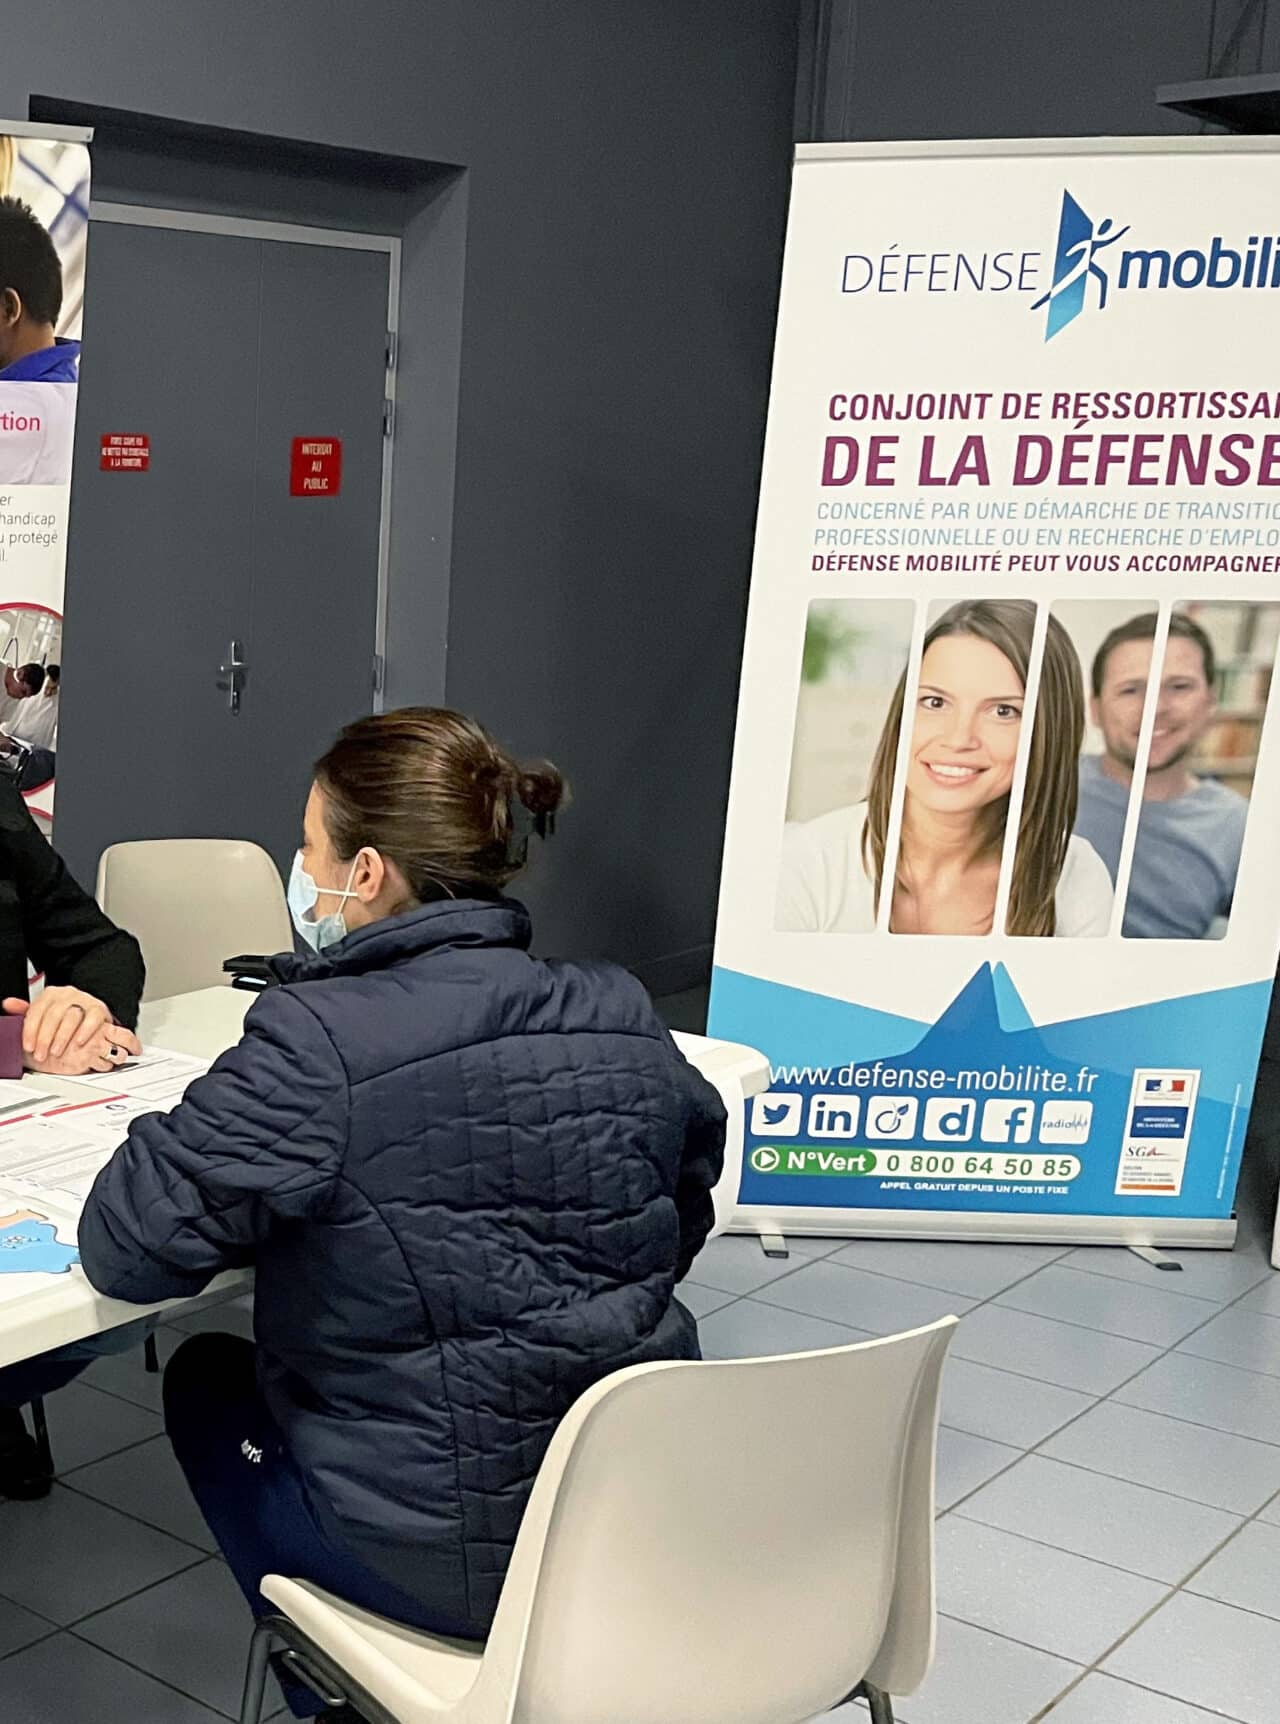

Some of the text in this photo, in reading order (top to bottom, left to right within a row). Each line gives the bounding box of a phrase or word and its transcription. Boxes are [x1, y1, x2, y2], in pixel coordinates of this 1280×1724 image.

[841, 243, 1041, 293] DÉFENSE
[828, 391, 1280, 421] CONJOINT DE RESSORTISSA
[302, 443, 332, 456] INTERDIT
[821, 419, 1280, 487] DE LA DÉFENSE
[311, 460, 322, 473] AU
[303, 477, 329, 490] PUBLIC
[817, 498, 926, 520] CONCERNÉ
[931, 502, 970, 520] PAR
[976, 502, 1018, 520] UNE
[1023, 497, 1138, 520] DÉMARCHE
[1143, 502, 1171, 520] DE
[9, 531, 59, 547] protégé
[814, 528, 996, 546] PROFESSIONNELLE
[1002, 528, 1029, 546] OU
[1036, 528, 1062, 546] EN
[1068, 528, 1184, 546] RECHERCHE
[812, 550, 901, 572] DÉFENSE
[906, 550, 1002, 572] MOBILITÉ
[1008, 555, 1060, 572] PEUT
[1065, 555, 1120, 572] VOUS
[787, 1151, 1072, 1176] N°Vert 0 800 64 50 85
[880, 1181, 1070, 1195] APPEL GRATUIT DEPUIS UN POSTE FIXE
